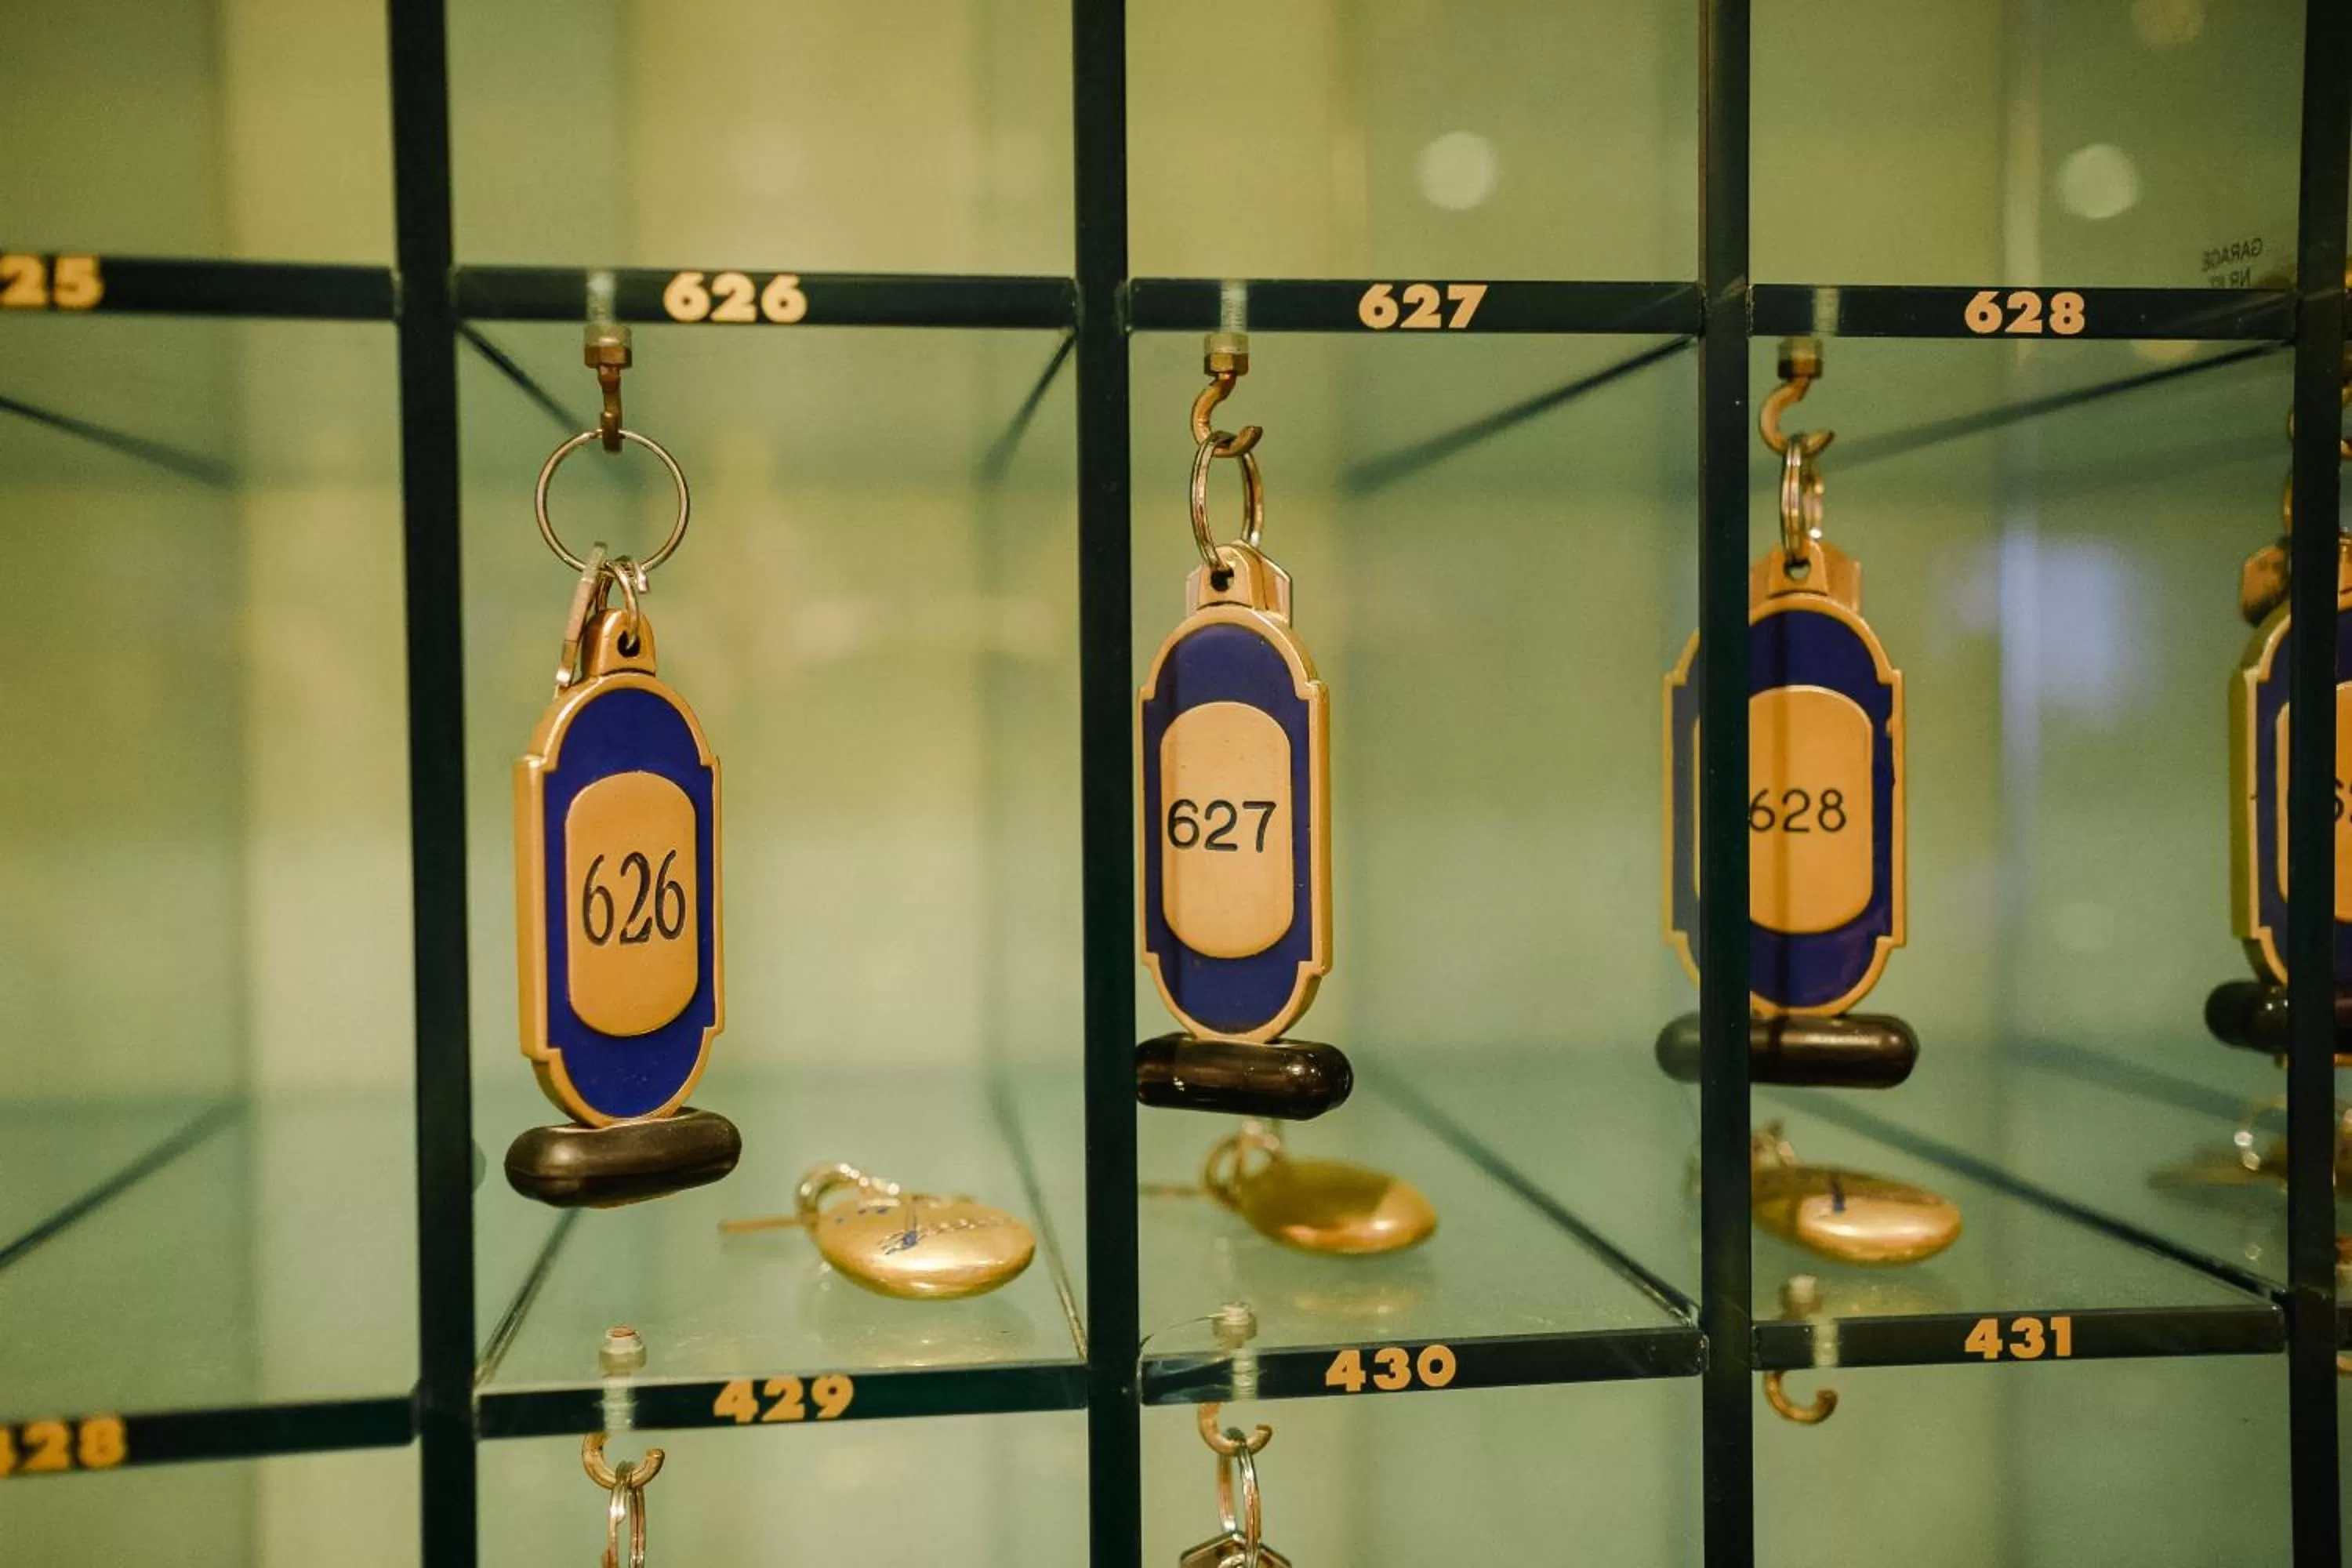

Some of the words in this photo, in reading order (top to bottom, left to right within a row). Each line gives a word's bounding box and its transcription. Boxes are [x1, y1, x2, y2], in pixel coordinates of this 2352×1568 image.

[662, 270, 808, 324] 626
[1359, 283, 1488, 329] 627
[1964, 291, 2085, 335] 628
[1167, 798, 1277, 853] 627
[1750, 787, 1846, 833] 628
[583, 849, 686, 946] 626
[1965, 1316, 2072, 1359] 431
[1325, 1344, 1457, 1392] 430
[713, 1374, 855, 1425] 429
